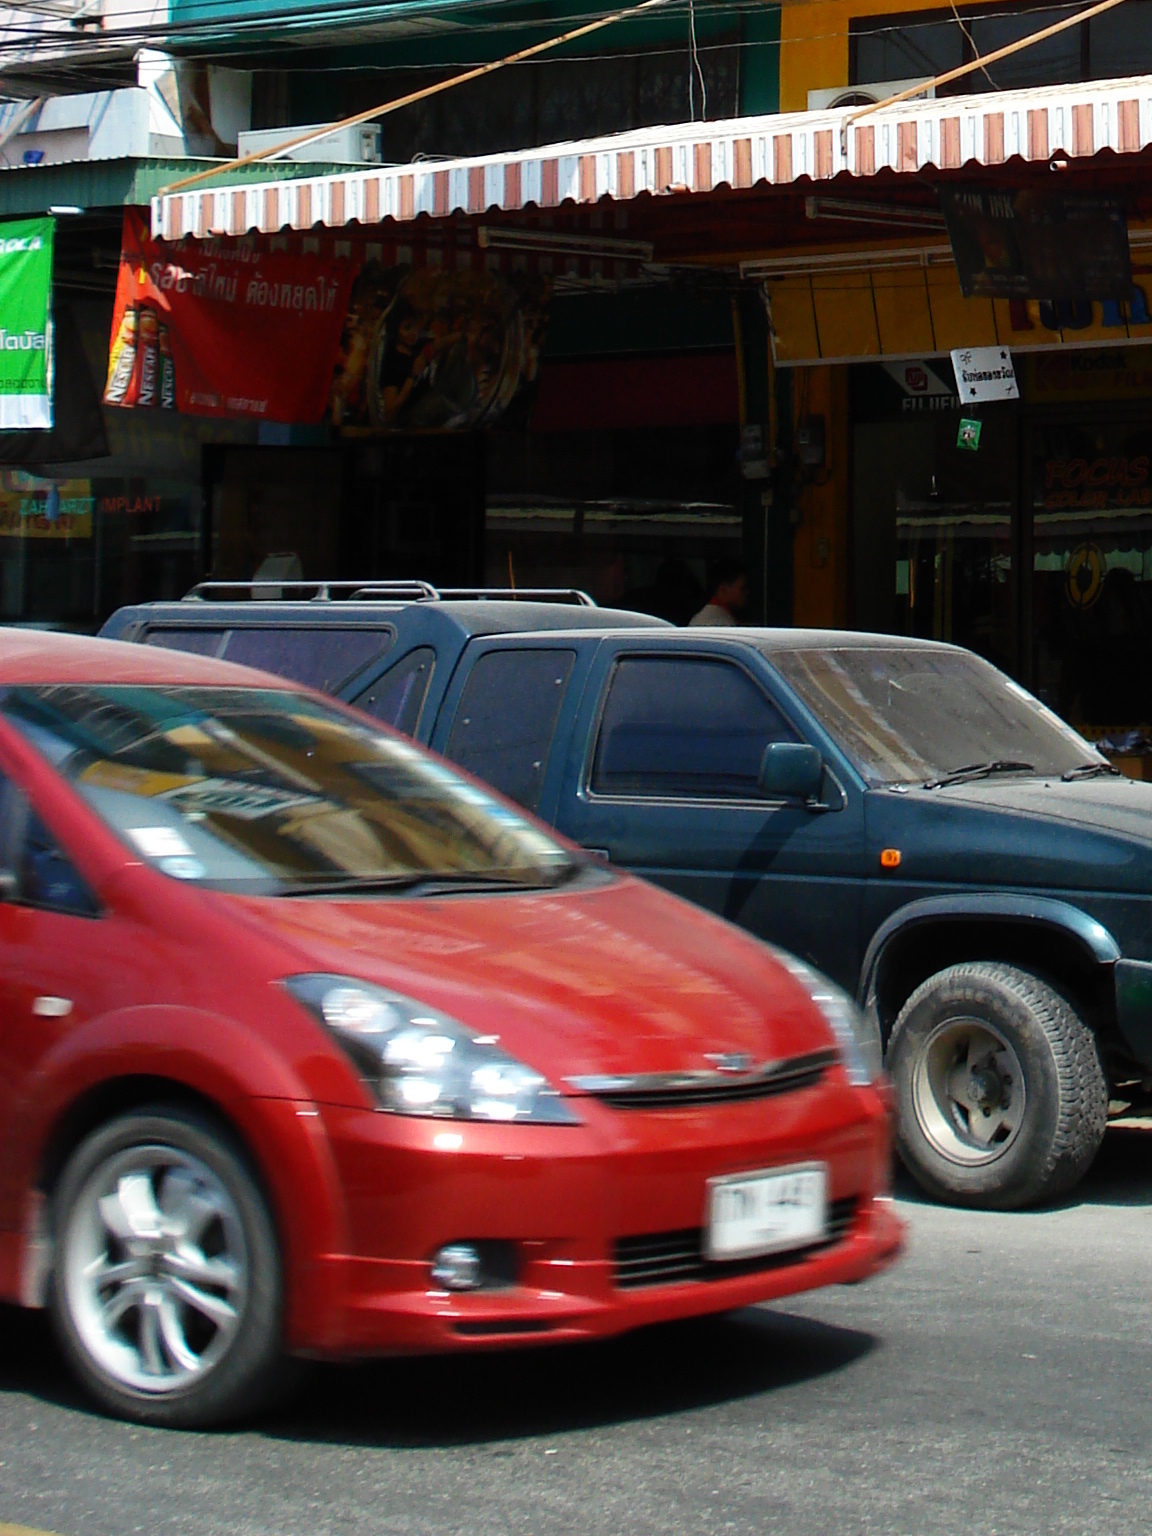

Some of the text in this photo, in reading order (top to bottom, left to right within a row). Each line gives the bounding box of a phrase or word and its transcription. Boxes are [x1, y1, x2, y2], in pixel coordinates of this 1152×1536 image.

[1070, 353, 1128, 371] Kodak
[1045, 456, 1149, 488] FOCUS
[20, 496, 95, 516] ZAHARZT
[102, 496, 162, 513] IMPLANT
[1116, 489, 1152, 506] LAB
